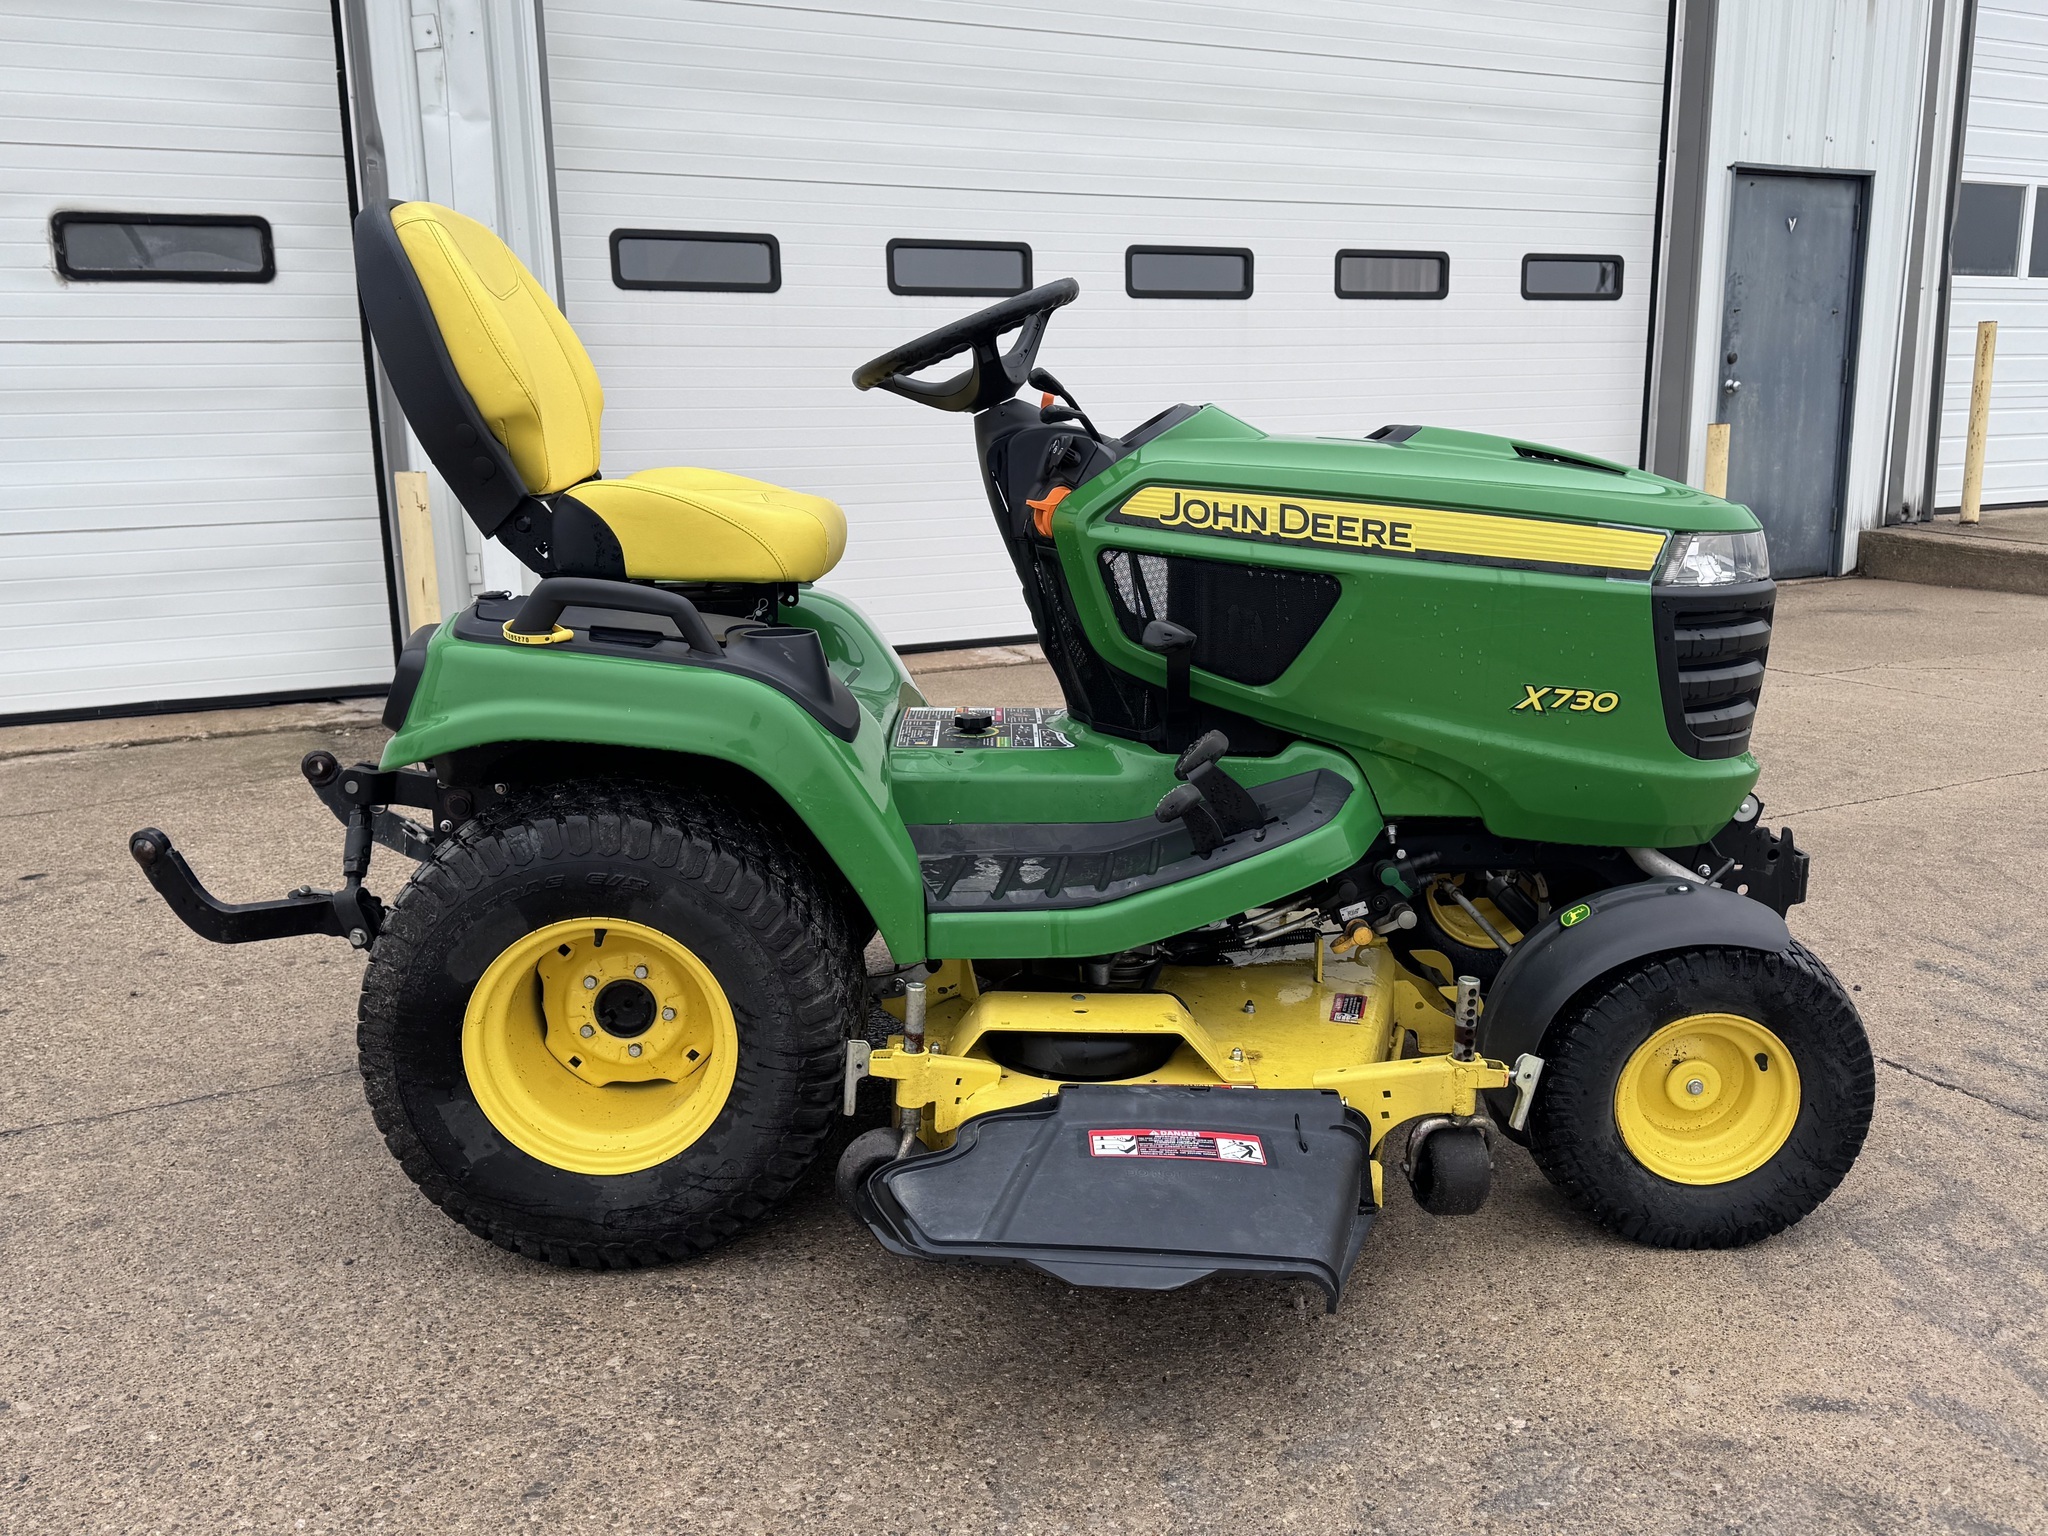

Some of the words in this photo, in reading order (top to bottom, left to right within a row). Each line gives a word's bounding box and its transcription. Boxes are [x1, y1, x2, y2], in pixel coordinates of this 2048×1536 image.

[1159, 492, 1267, 531] JOHN
[1279, 503, 1413, 548] DEERE
[1511, 684, 1620, 714] X730
